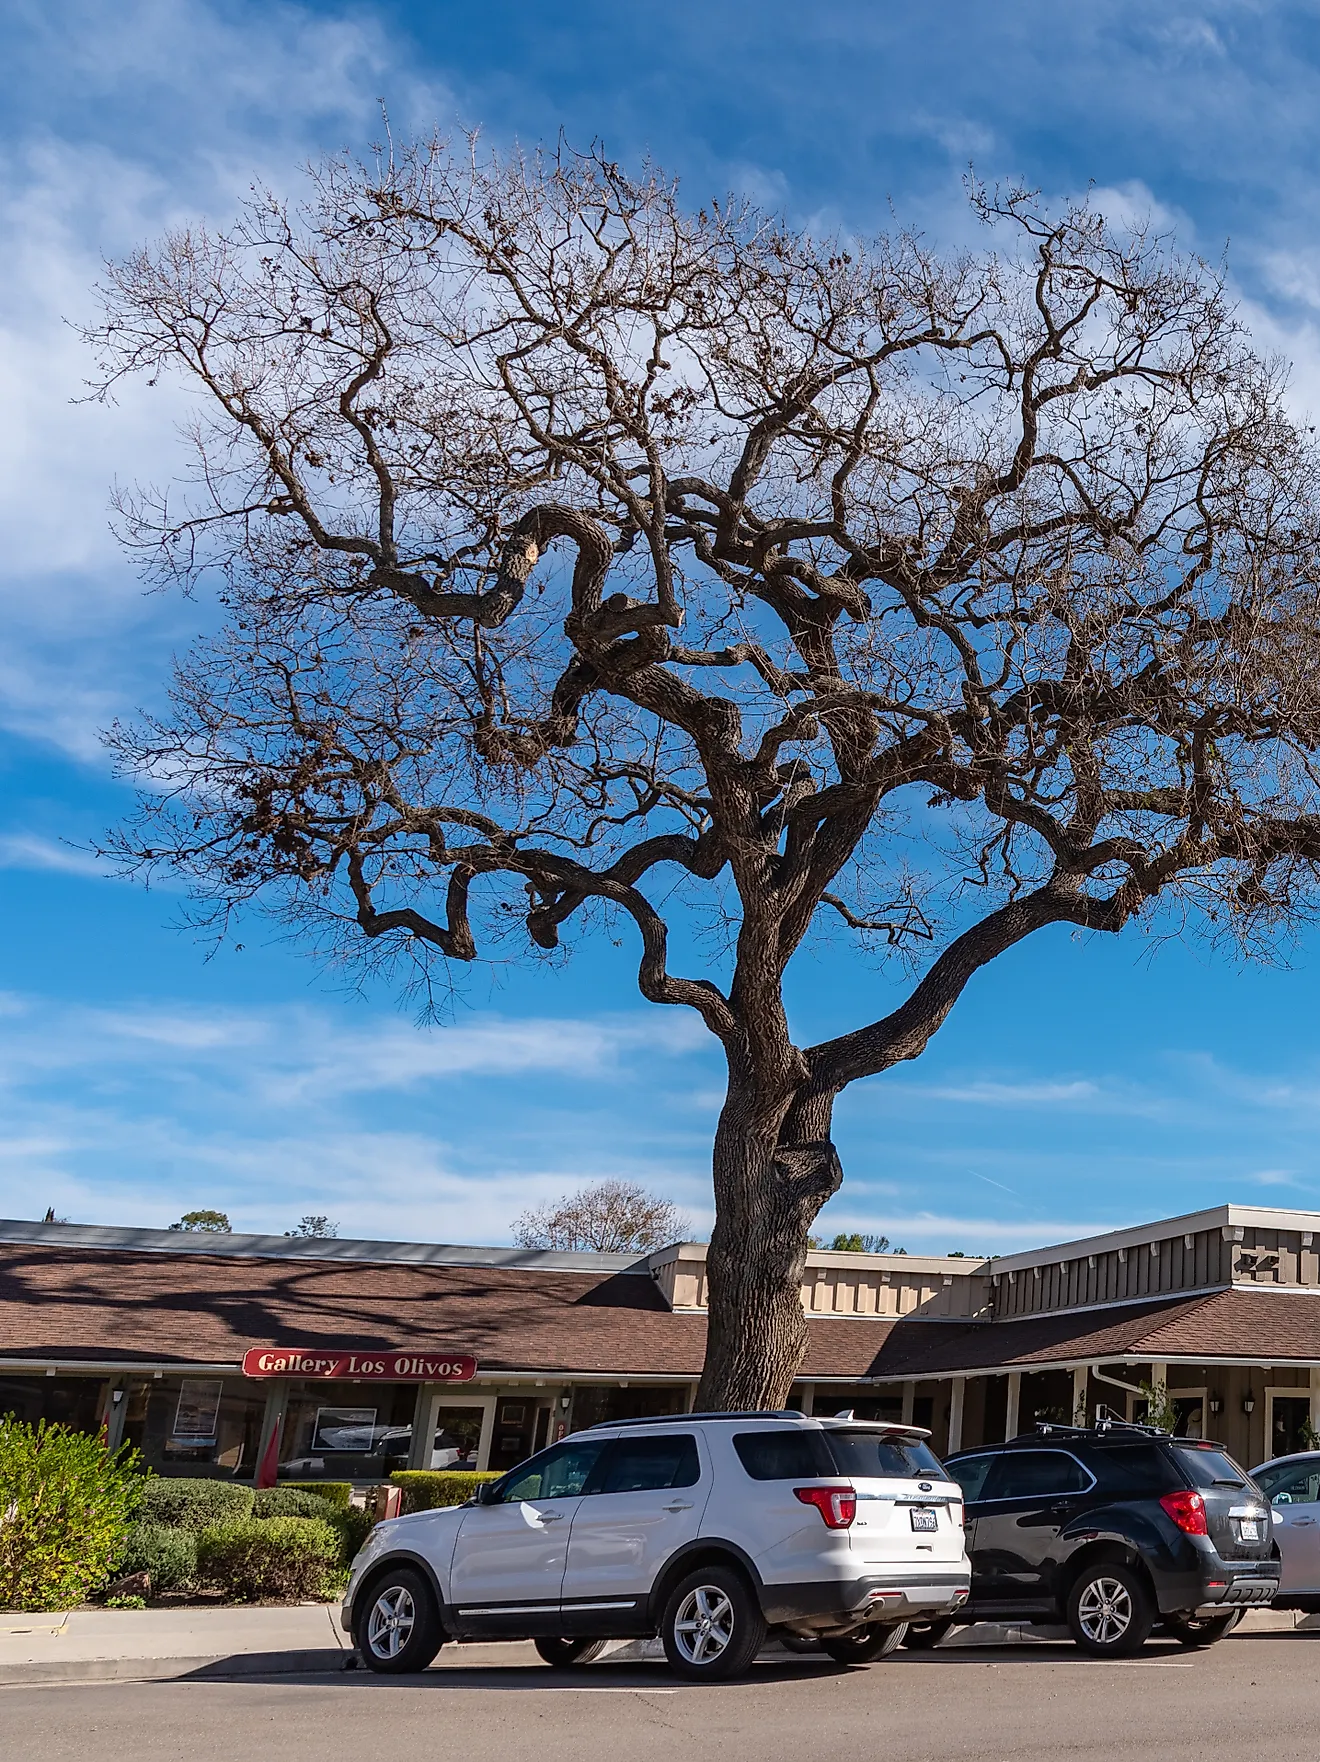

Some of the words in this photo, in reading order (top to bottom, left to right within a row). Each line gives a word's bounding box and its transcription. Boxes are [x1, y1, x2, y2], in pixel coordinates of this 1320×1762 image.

[258, 1353, 340, 1376] Gallery
[347, 1356, 386, 1374] Los
[394, 1357, 464, 1376] Olivos
